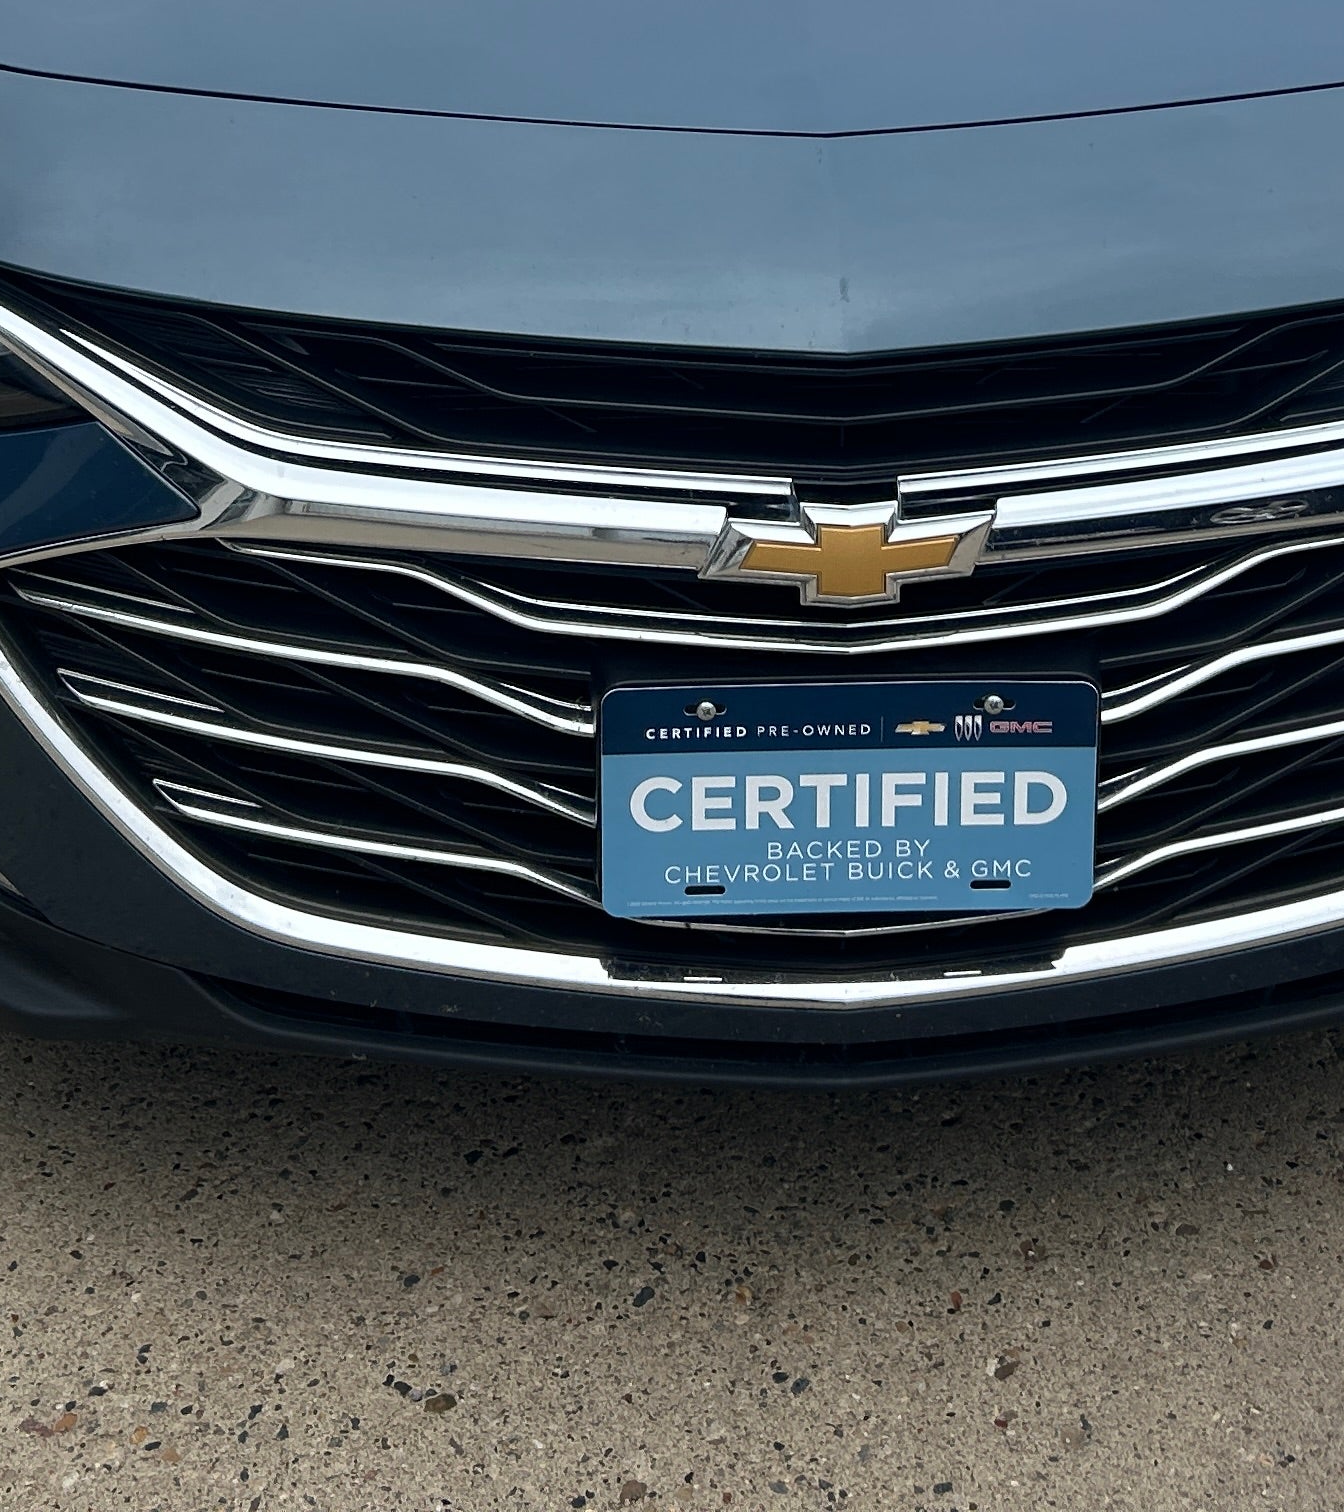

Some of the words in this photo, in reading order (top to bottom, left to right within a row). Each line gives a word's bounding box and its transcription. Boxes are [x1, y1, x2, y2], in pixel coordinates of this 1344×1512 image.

[645, 725, 748, 740] CERTIFIED
[757, 723, 872, 738] PRE-OWNED
[989, 719, 1053, 734] GMC
[629, 771, 1068, 832] CERTIFIED
[767, 839, 882, 860] BACKED
[896, 839, 931, 858] BY
[664, 862, 835, 884] CHEVROLET
[848, 860, 934, 880] BUICK
[944, 860, 960, 879] &
[971, 859, 1032, 878] GMC
